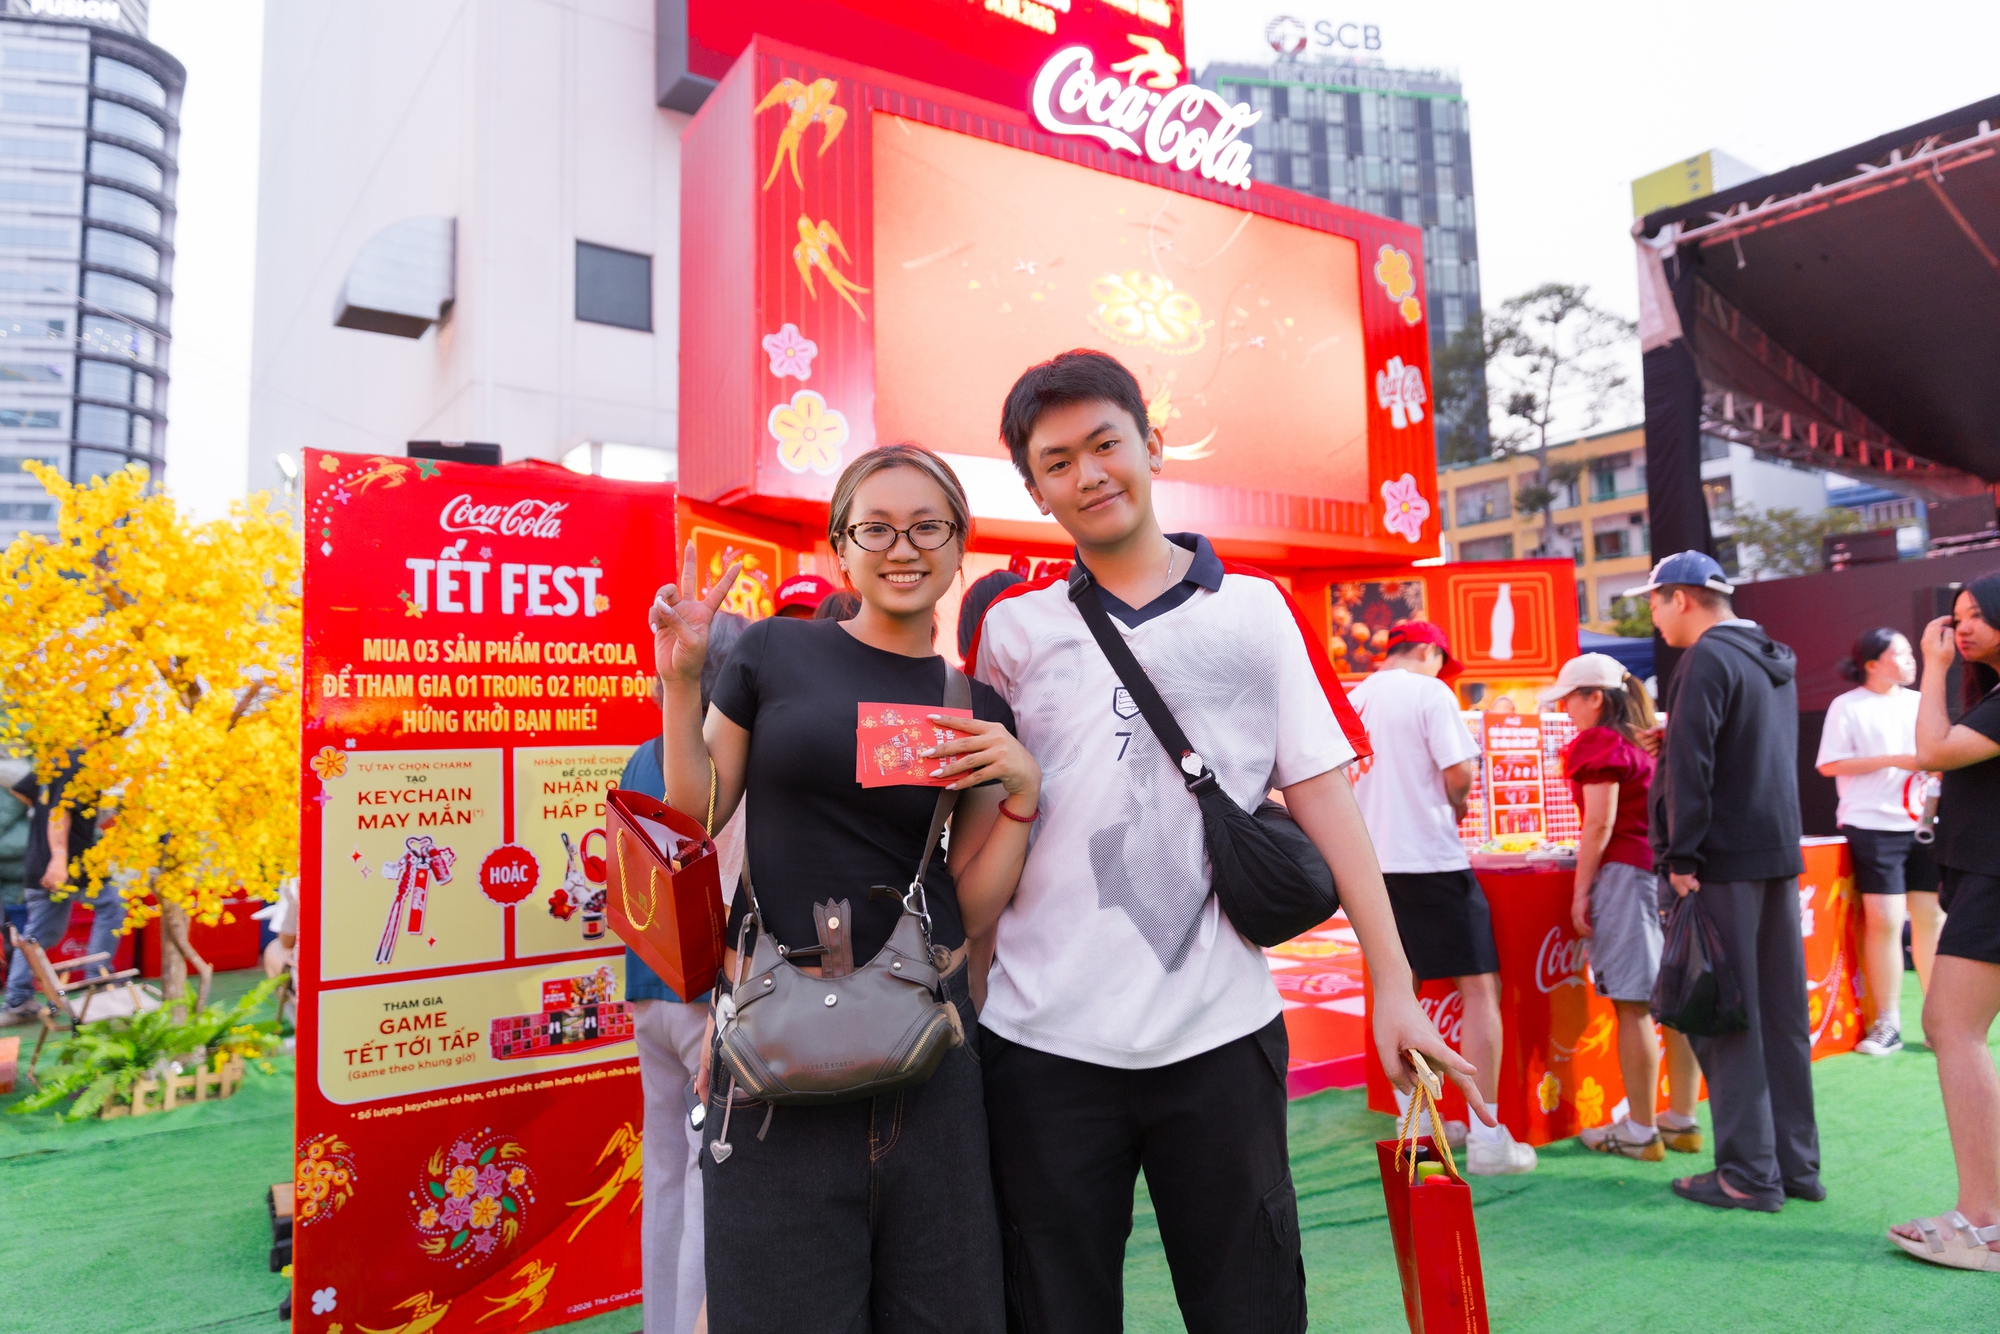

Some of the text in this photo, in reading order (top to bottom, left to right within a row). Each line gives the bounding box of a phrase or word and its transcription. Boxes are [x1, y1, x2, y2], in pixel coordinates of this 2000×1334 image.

[1314, 20, 1382, 50] SCB
[1033, 46, 1262, 190] Coca-Cola
[439, 494, 569, 538] Coca-Cola
[406, 539, 603, 617] TẾT FEST
[363, 632, 637, 664] MUA 03 SẢN PHẨM COCA-COLA
[322, 664, 657, 703] ĐỂ THAM GIA 01 TRONG 02 HOẠT ĐỘN
[402, 702, 598, 737] HỨNG KHỞI BẠN NHÉ!
[1115, 732, 1132, 761] 7
[376, 763, 395, 771] TAY
[398, 762, 430, 773] CHỌN
[433, 760, 472, 770] CHARM
[578, 768, 592, 776] CÓ
[610, 768, 625, 777] HỘ
[406, 774, 427, 786] TẠO
[543, 777, 598, 797] NHẬN
[358, 787, 472, 805] KEYCHAIN
[543, 798, 587, 819] HẤP
[357, 813, 411, 831] MAY
[489, 861, 529, 887] HOẶC
[383, 996, 443, 1012] THAM GIA
[379, 1012, 447, 1035] GAME
[344, 1026, 480, 1066] TẾT TỚI TẤP
[348, 1068, 387, 1081] (Game
[389, 1063, 415, 1075] theo
[418, 1057, 452, 1070] khung
[404, 1097, 449, 1113] keychain
[450, 1094, 462, 1104] có
[486, 1088, 498, 1098] có
[608, 1067, 625, 1077] nha
